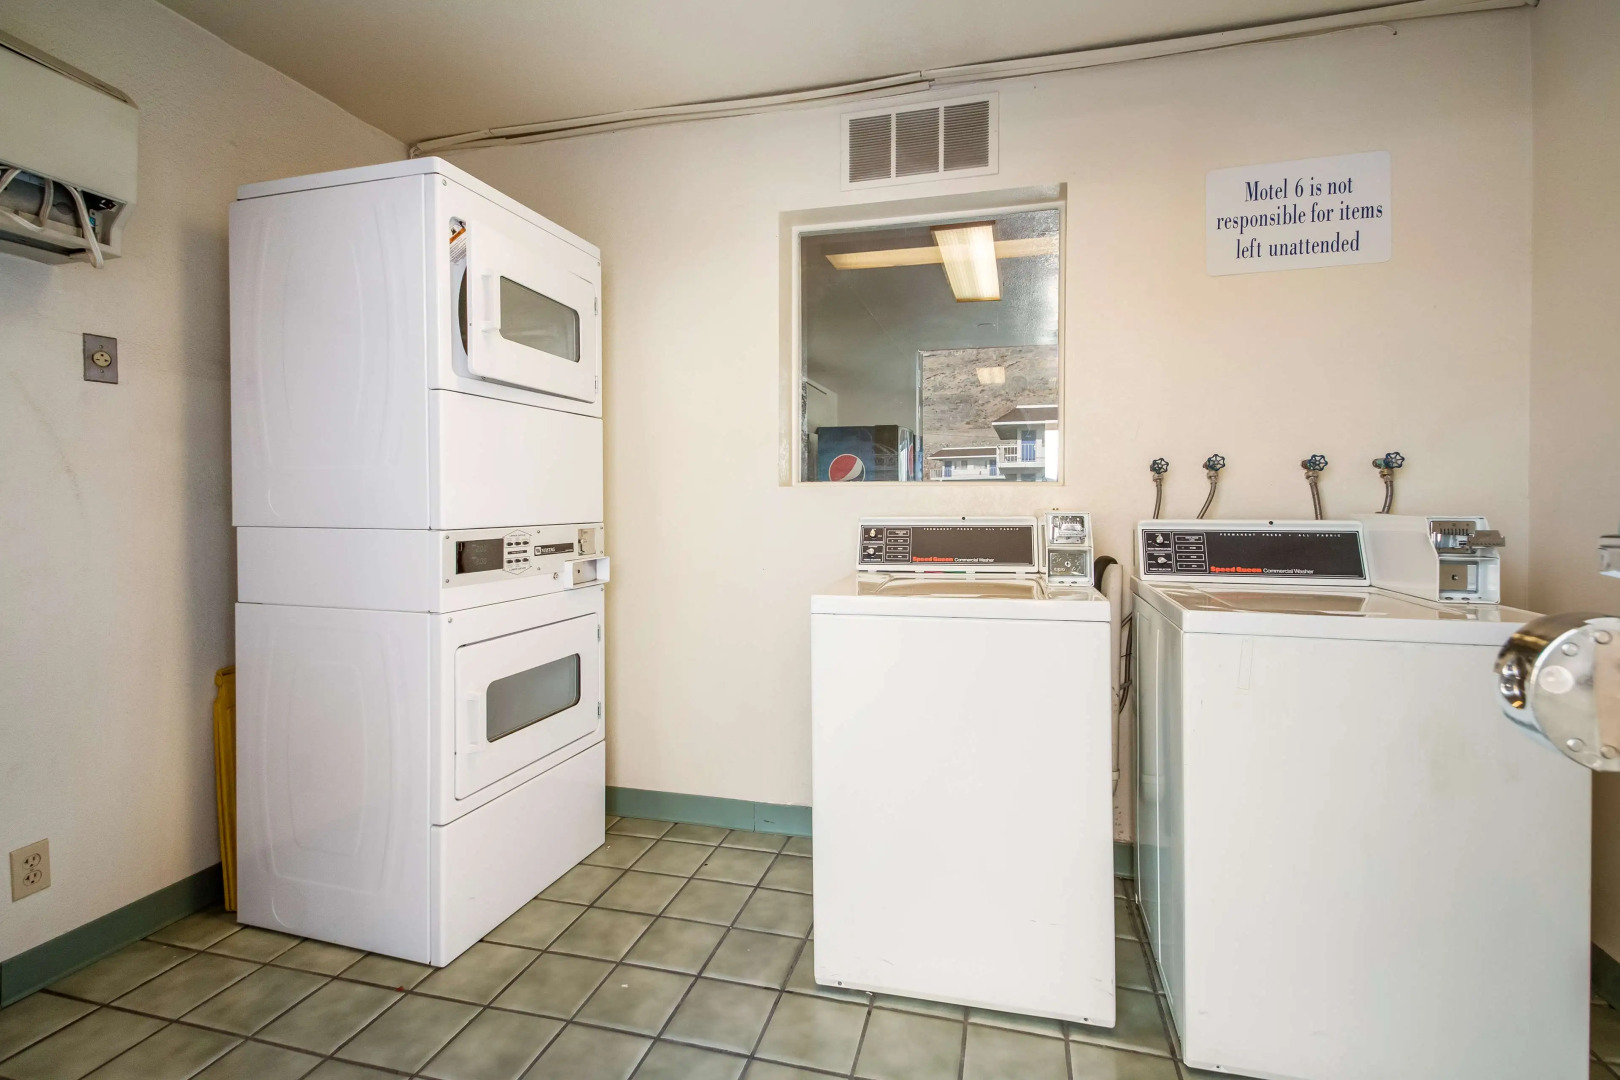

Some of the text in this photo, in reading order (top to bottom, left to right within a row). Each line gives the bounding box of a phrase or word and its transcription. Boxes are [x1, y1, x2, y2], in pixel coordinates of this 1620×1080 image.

[1245, 177, 1353, 202] Motel 6 is not
[1216, 201, 1383, 235] responsible for items
[1236, 230, 1360, 259] left unattended
[1210, 565, 1236, 573] Speed
